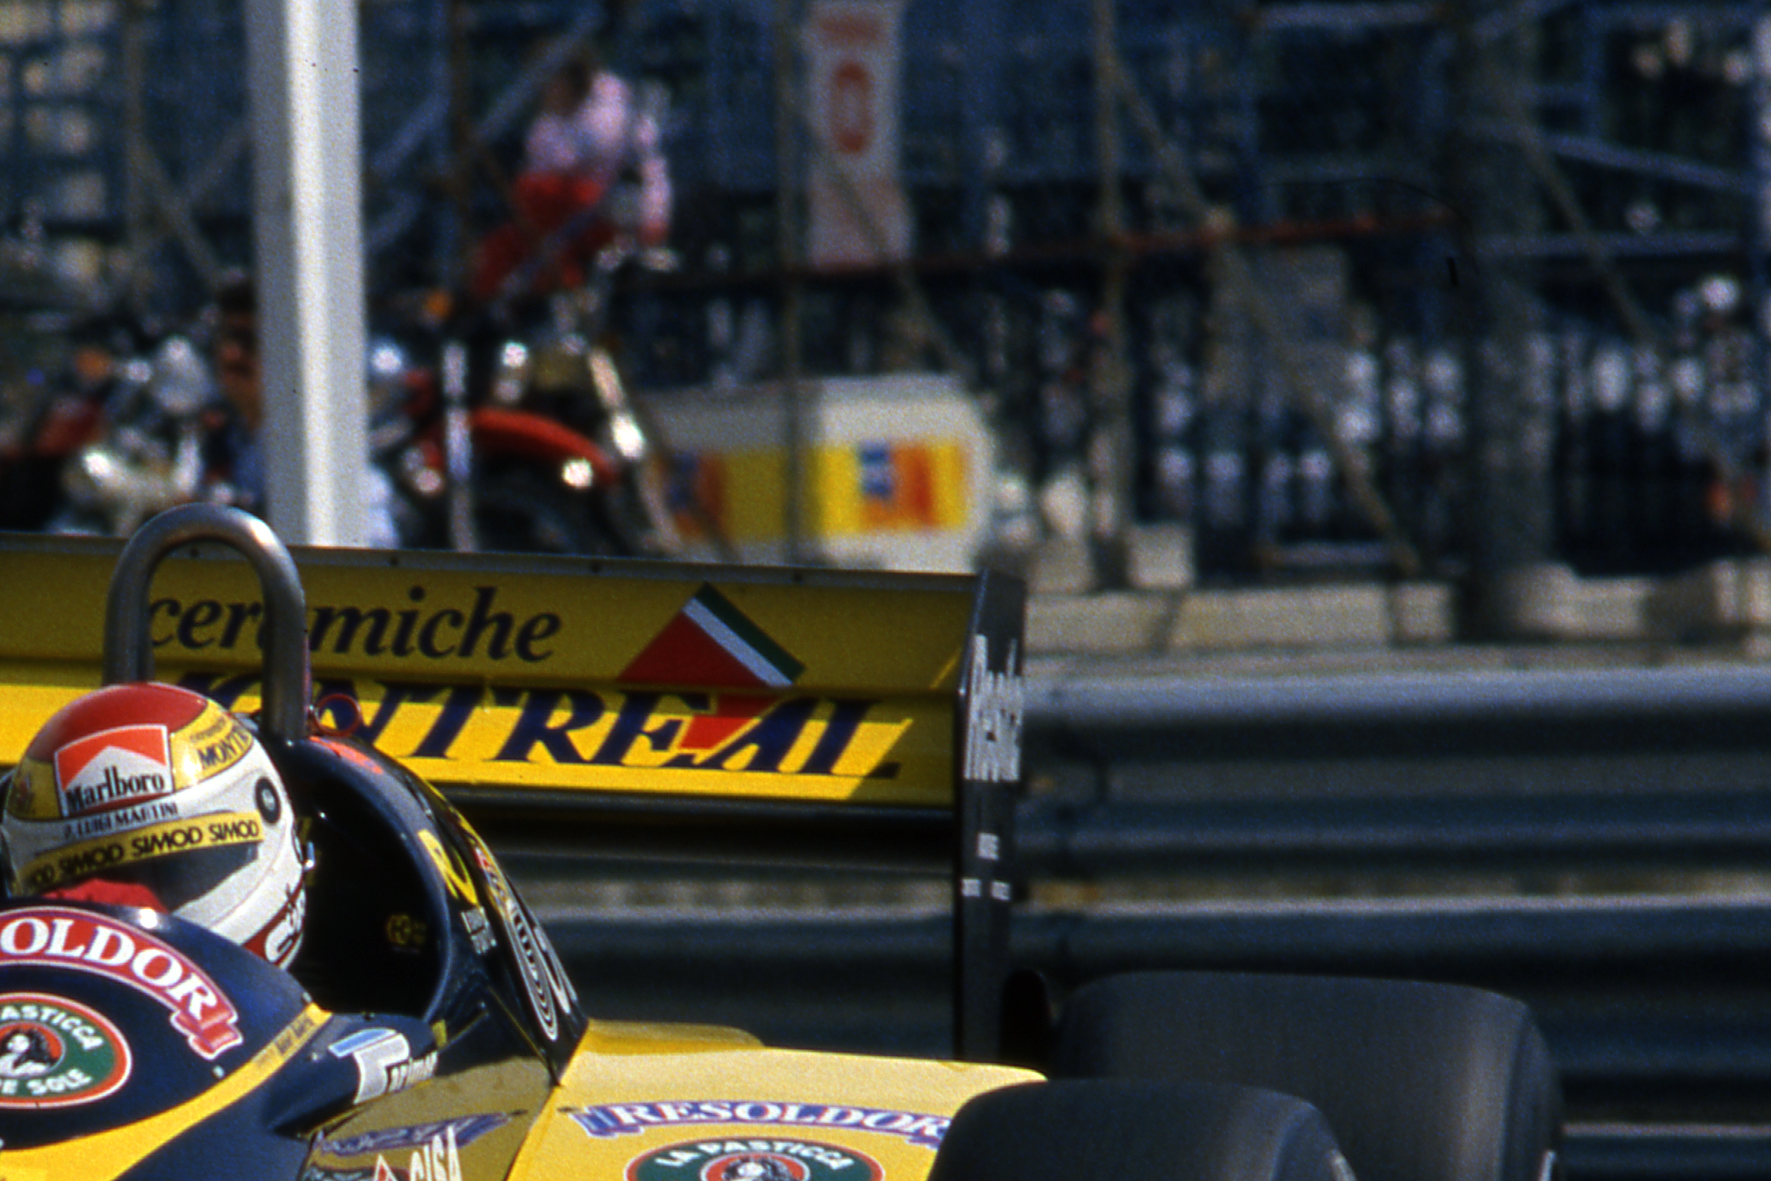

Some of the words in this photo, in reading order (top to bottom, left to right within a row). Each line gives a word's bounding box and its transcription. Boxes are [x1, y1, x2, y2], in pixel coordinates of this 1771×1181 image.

[148, 585, 562, 663] cermiche
[66, 765, 165, 812] Marlboro
[131, 825, 203, 857] SIMOD
[208, 820, 259, 842] SIMOD
[26, 1068, 93, 1096] SOLE
[655, 1148, 702, 1169] LA
[697, 1140, 855, 1172] PASTICCA
